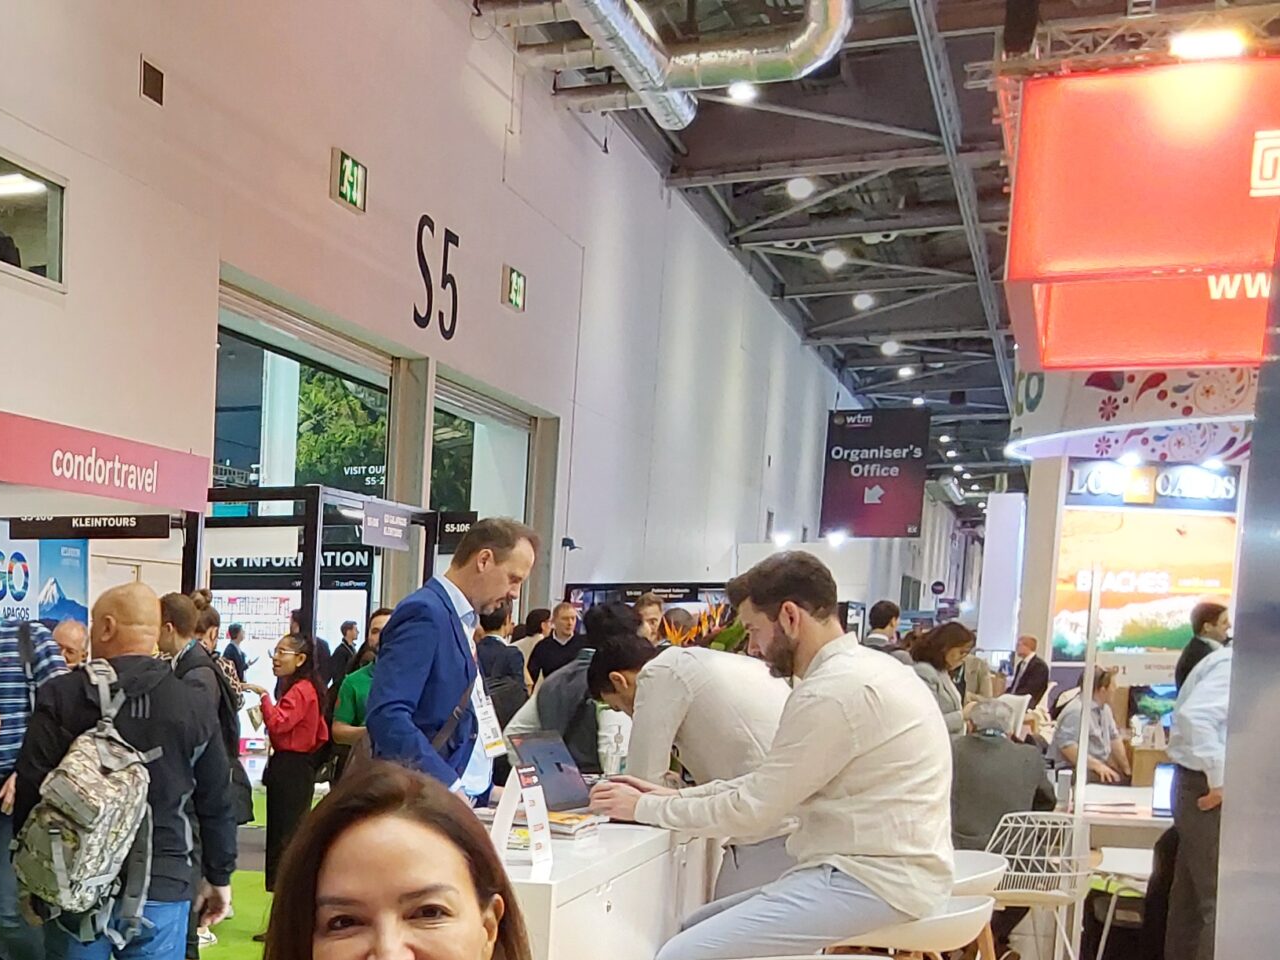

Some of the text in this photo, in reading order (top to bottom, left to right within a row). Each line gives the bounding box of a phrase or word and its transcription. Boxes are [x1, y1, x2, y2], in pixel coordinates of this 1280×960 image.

[413, 214, 459, 341] S5
[846, 413, 873, 424] wtm
[831, 444, 923, 462] Organiser's
[51, 448, 158, 494] condortravel
[343, 466, 366, 476] VISIT
[850, 463, 900, 477] Office
[72, 517, 137, 528] KLEINTOURS
[243, 551, 369, 568] INFORTION
[1076, 570, 1170, 594] BACHES
